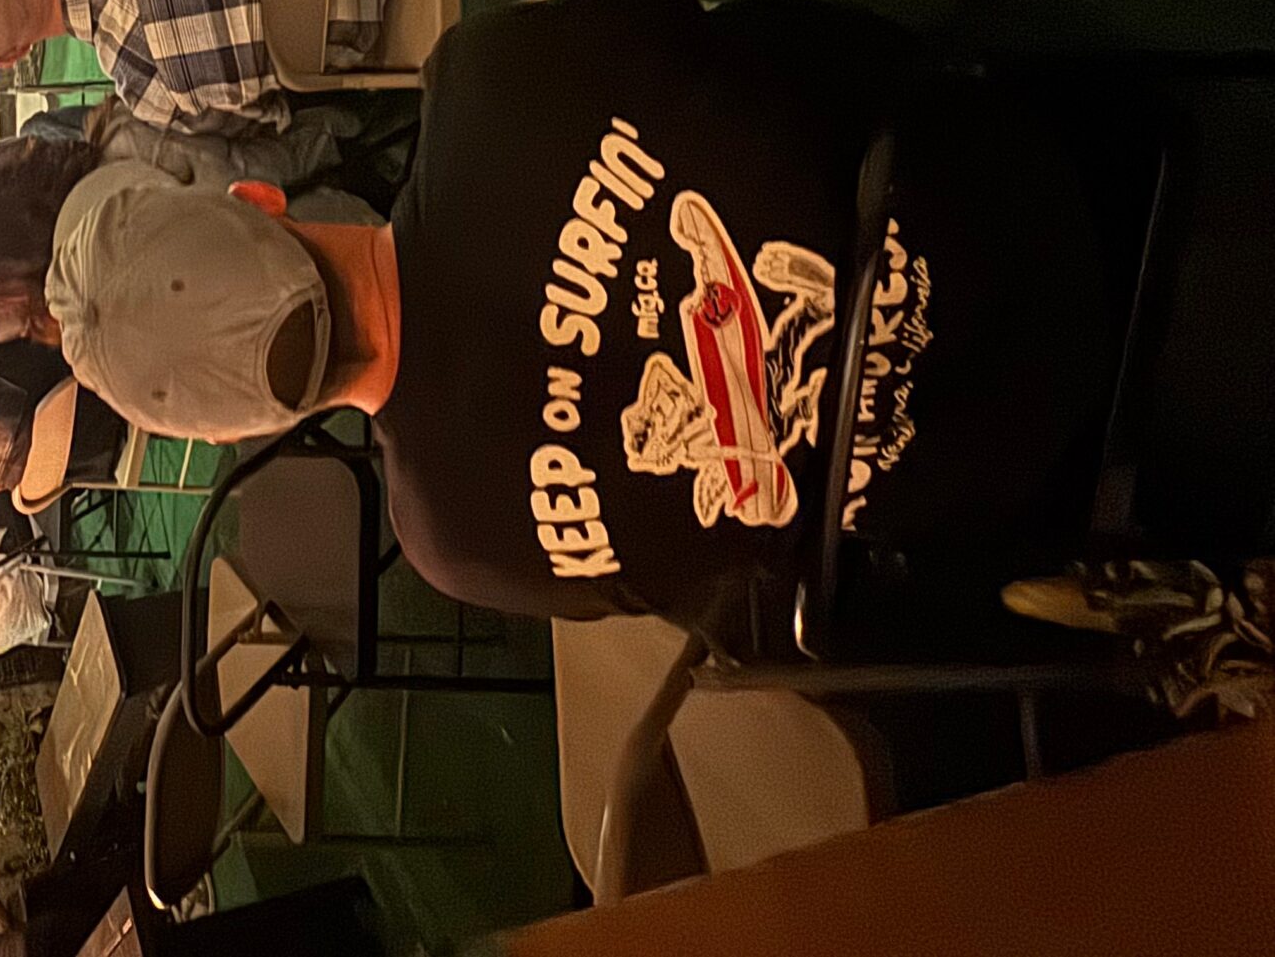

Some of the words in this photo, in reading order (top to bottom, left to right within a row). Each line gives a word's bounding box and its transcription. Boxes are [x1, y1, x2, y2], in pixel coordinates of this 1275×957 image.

[539, 116, 666, 357] SURFIN'
[894, 255, 934, 375] Clifornia
[542, 366, 583, 432] ON
[529, 444, 621, 578] KEEP
